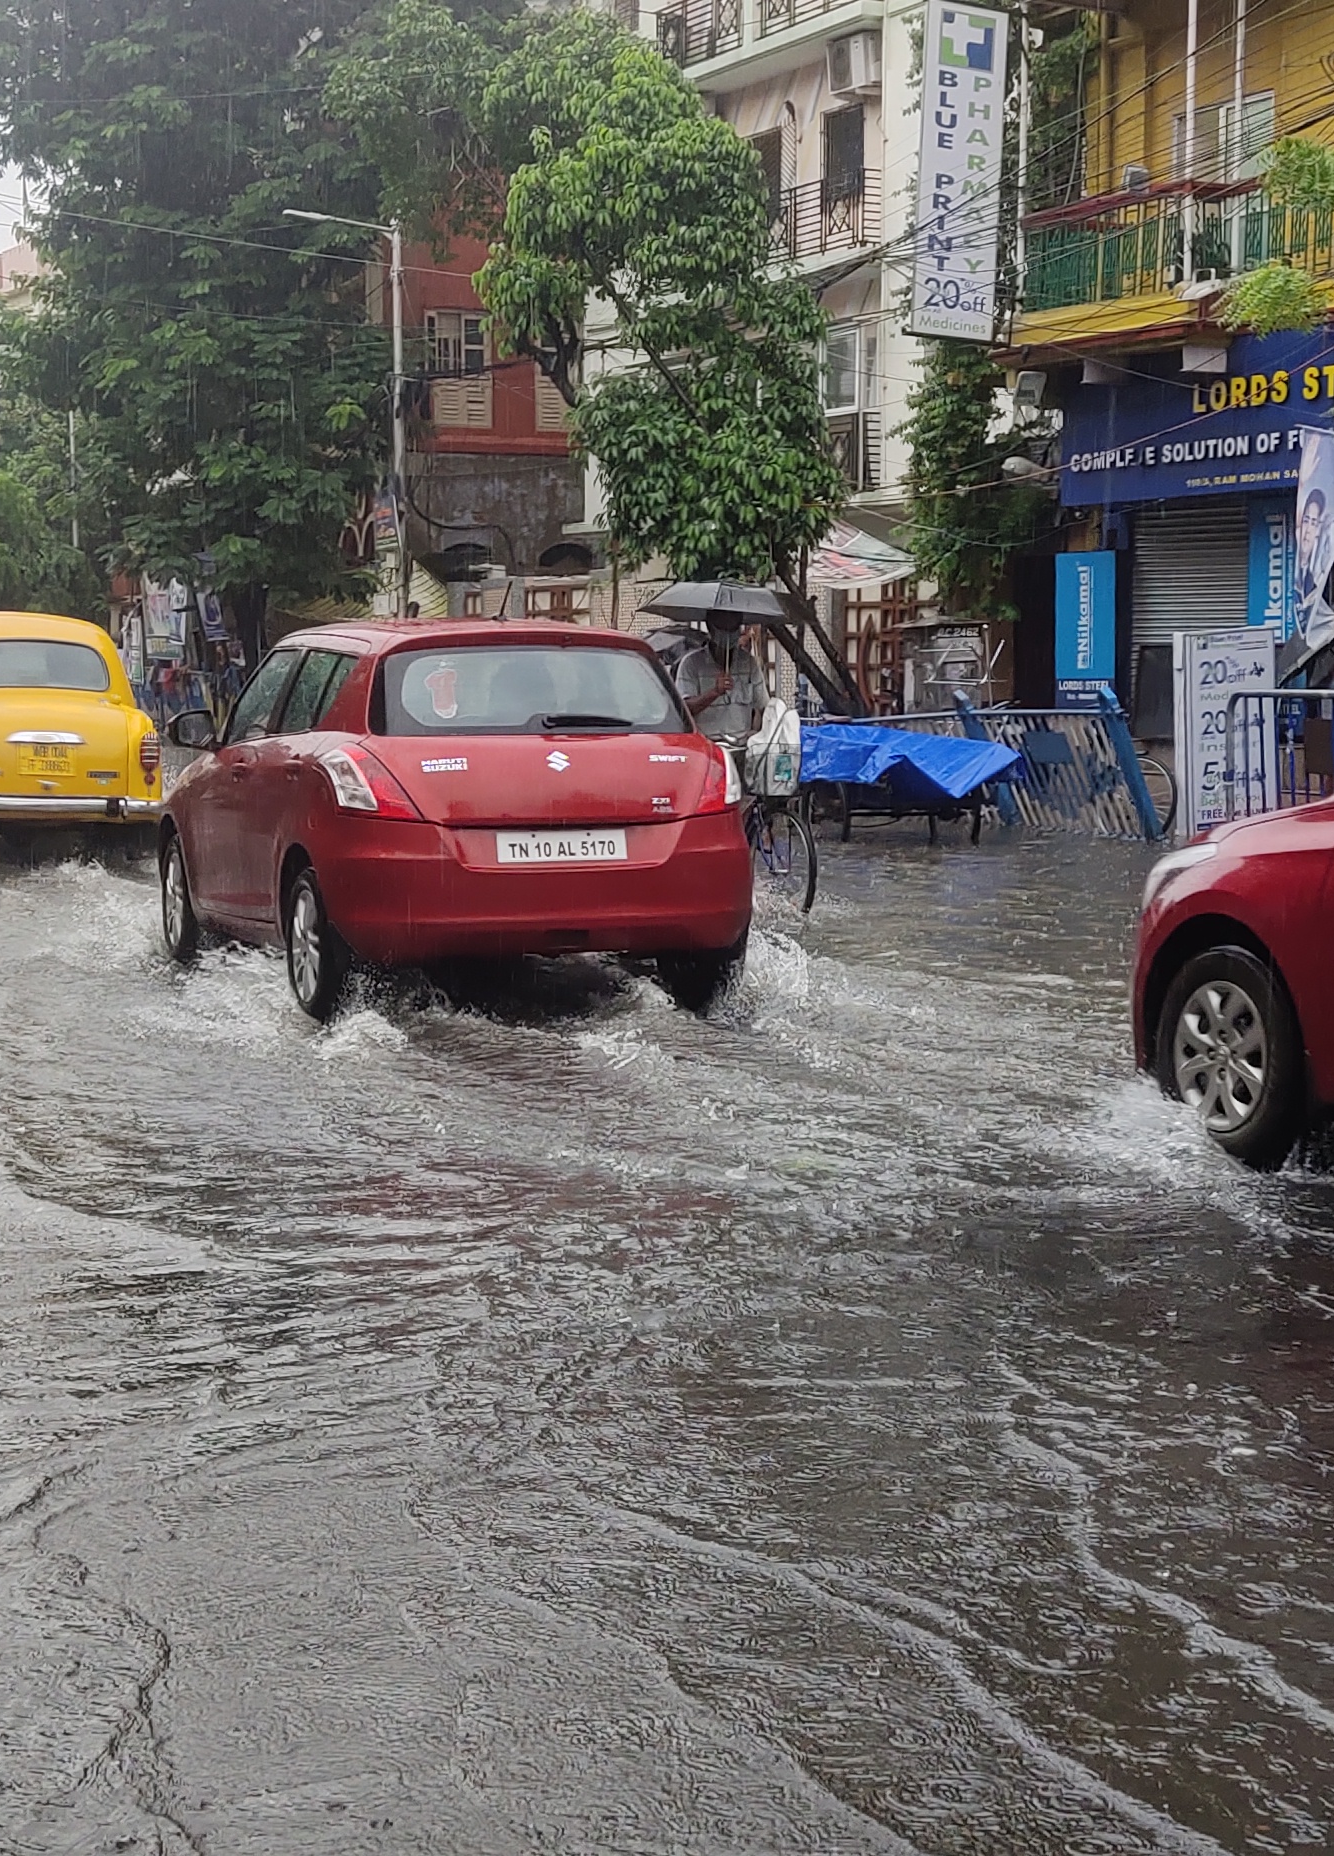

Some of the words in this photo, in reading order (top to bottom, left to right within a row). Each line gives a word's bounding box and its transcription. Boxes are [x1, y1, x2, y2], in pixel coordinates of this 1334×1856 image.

[935, 70, 958, 149] BLUE
[928, 173, 954, 271] PRINT
[919, 315, 986, 334] Medicines
[1193, 370, 1290, 414] LORDS
[1161, 434, 1250, 464] SOLUTION
[1257, 431, 1281, 452] OF
[1214, 475, 1237, 486] RAM
[1240, 471, 1281, 483] MOHAN
[1077, 565, 1090, 654] Nilkamal
[1058, 680, 1084, 691] LORDS
[421, 757, 467, 766] MARUTI
[649, 754, 687, 763] SWIFT
[422, 763, 467, 773] SUZUKI
[509, 843, 529, 858] TN
[534, 841, 551, 858] 10
[557, 840, 576, 857] AL
[581, 840, 616, 856] 5170
